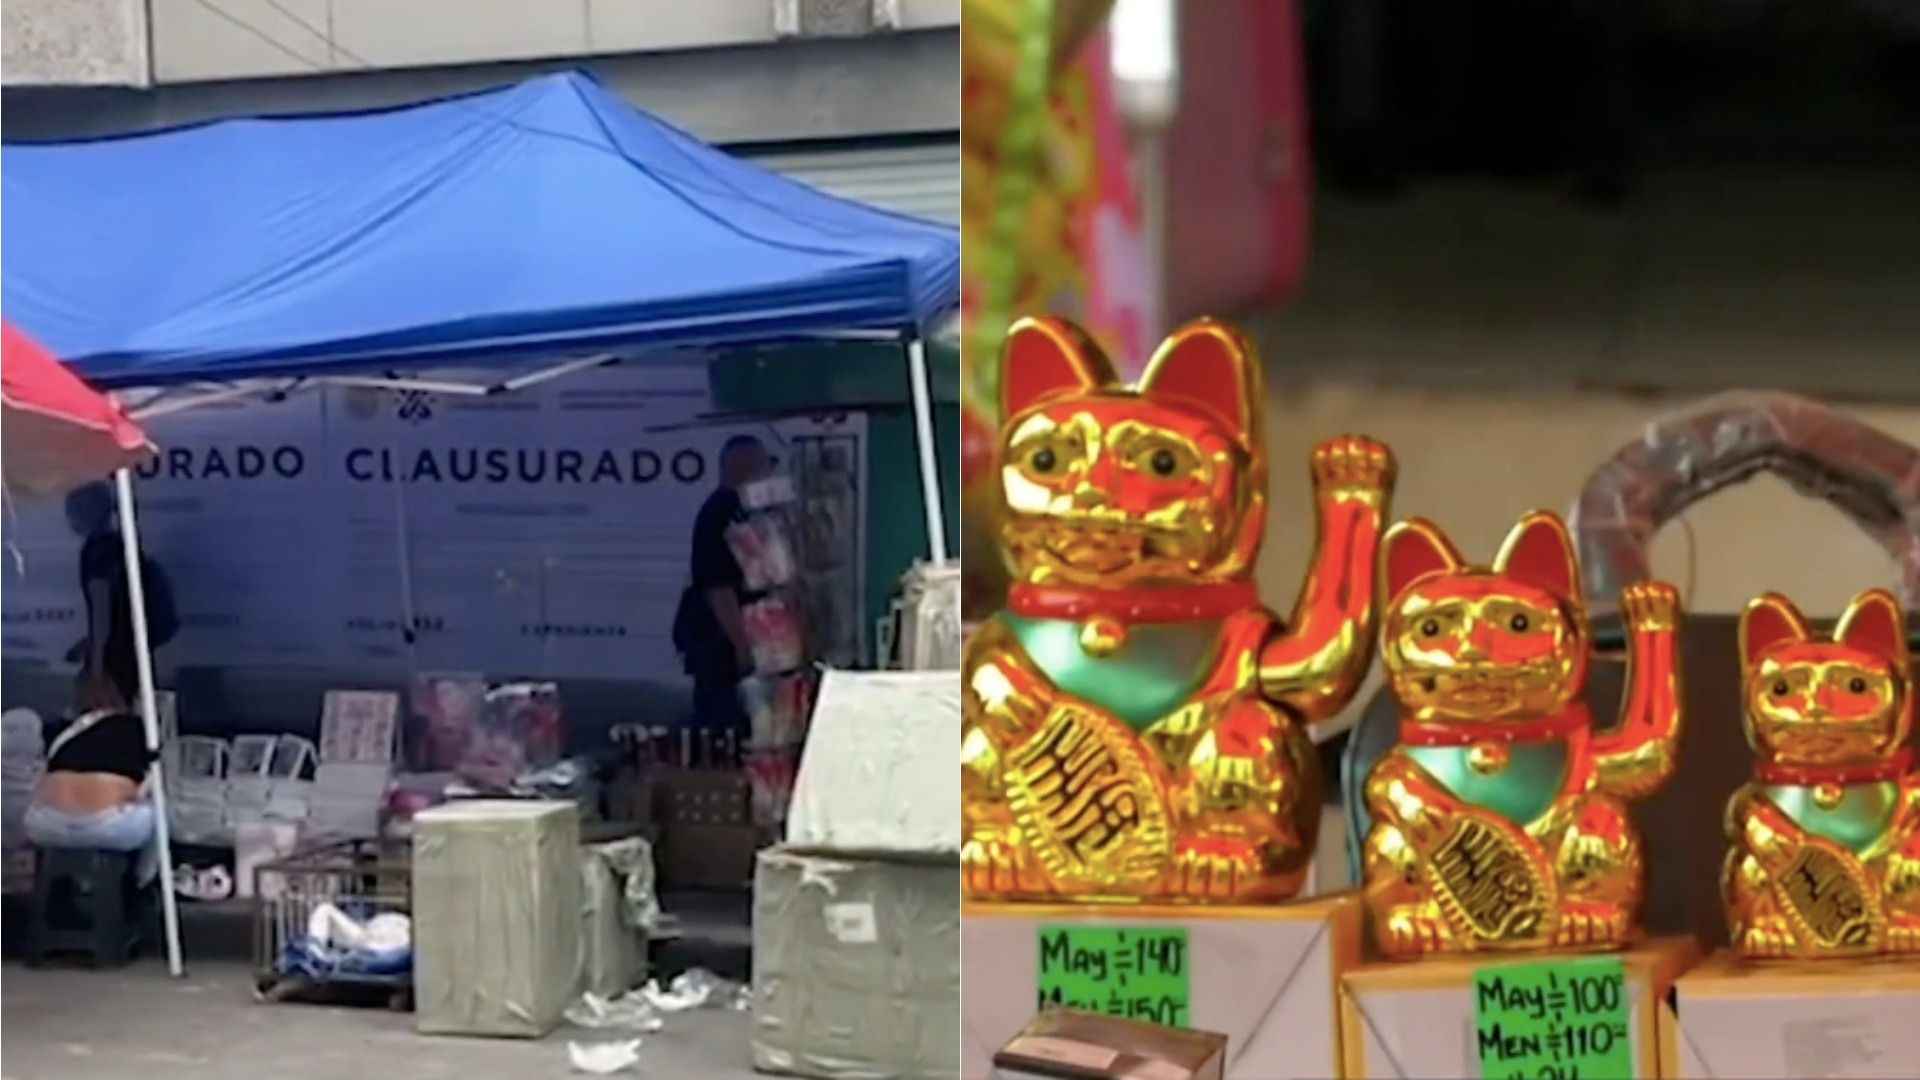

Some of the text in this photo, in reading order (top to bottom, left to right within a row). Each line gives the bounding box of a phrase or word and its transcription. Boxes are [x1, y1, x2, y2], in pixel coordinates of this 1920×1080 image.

[108, 446, 304, 480] URADO
[345, 448, 706, 483] CLAUSURADO
[1040, 929, 1107, 982] May
